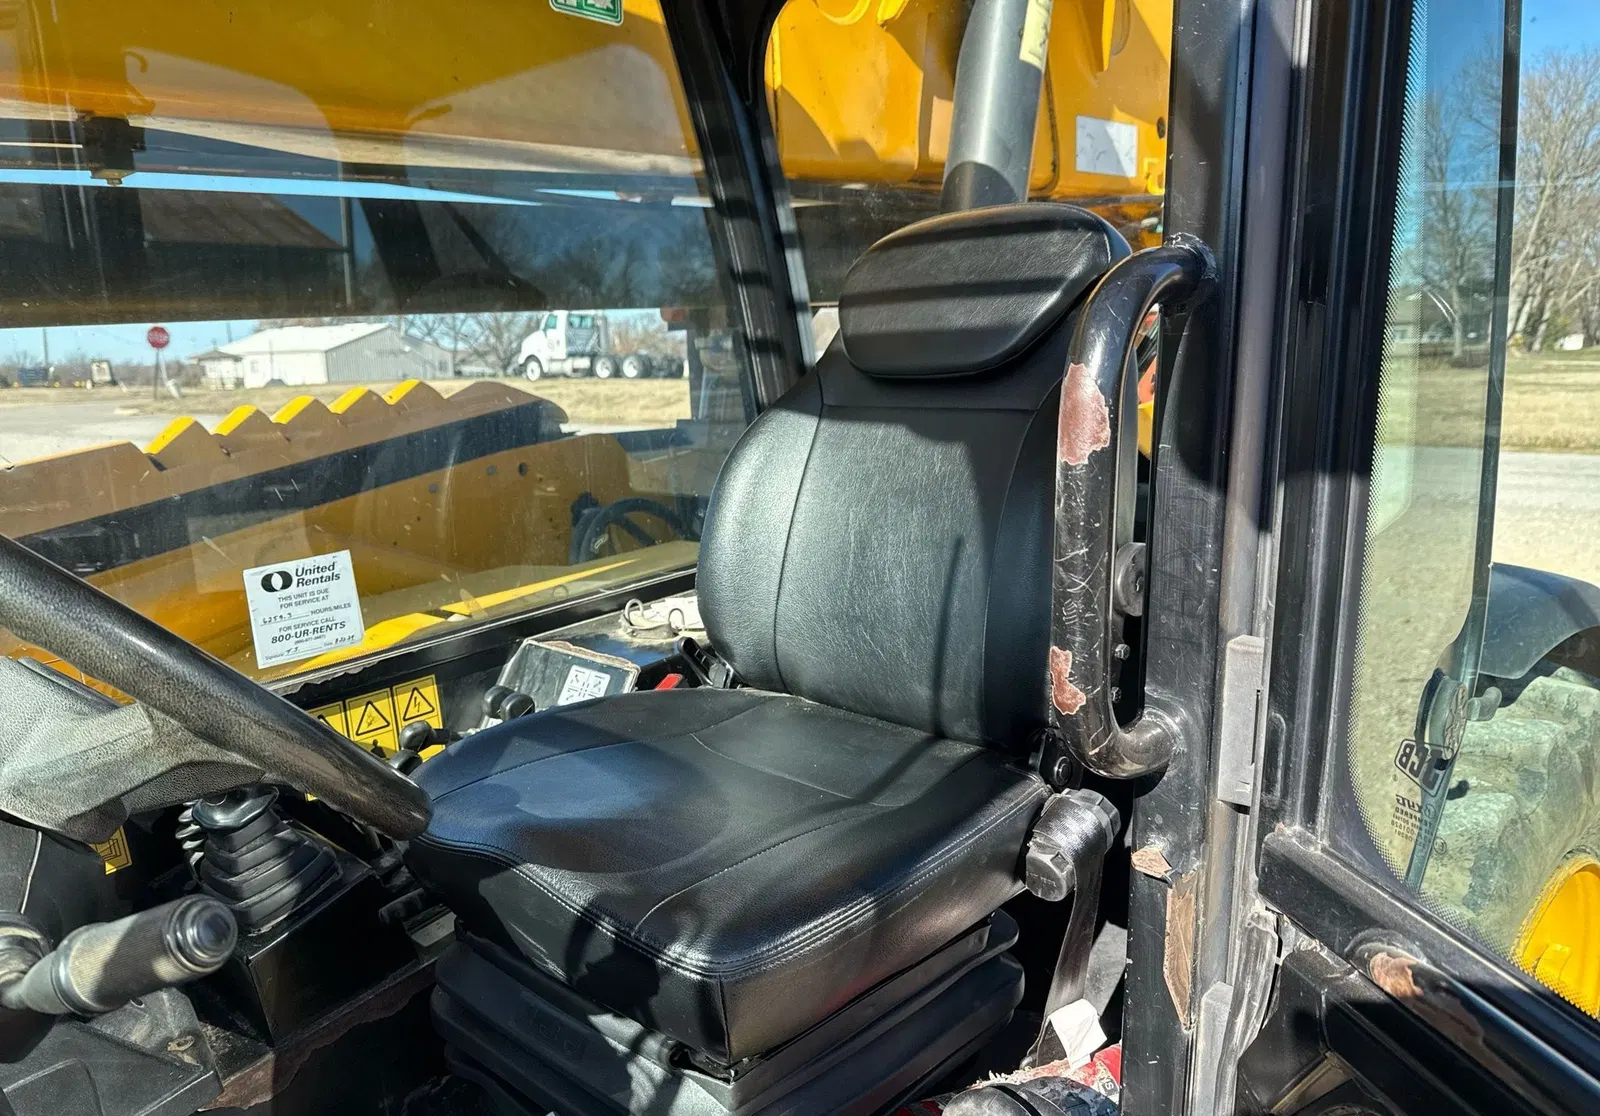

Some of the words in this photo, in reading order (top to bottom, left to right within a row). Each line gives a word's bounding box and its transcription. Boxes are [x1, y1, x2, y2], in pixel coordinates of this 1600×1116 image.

[295, 561, 336, 577] United
[296, 572, 341, 588] Rentals
[278, 594, 293, 603] THIS
[294, 591, 308, 600] UNIT
[316, 588, 329, 596] DUE
[280, 601, 294, 609] FOR
[294, 596, 321, 607] SERVICE
[311, 603, 352, 615] HOURS/MILES
[271, 620, 346, 644] 800-UR-RENTS
[279, 625, 293, 633] FOR
[293, 620, 319, 631] SERVICE
[320, 616, 336, 624] CALL
